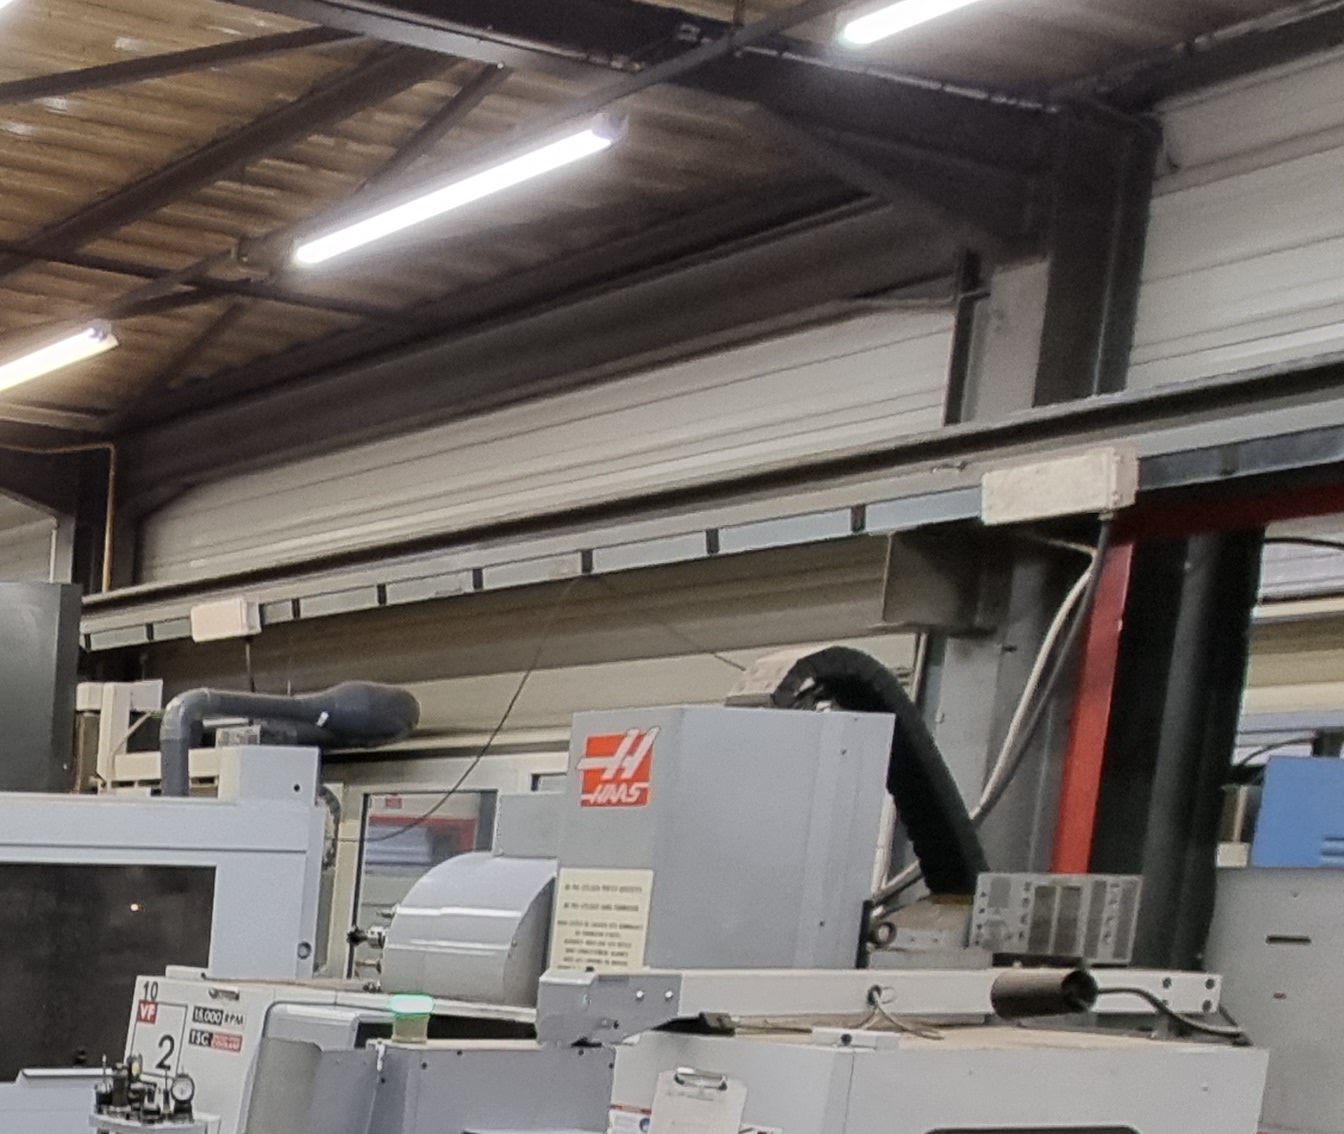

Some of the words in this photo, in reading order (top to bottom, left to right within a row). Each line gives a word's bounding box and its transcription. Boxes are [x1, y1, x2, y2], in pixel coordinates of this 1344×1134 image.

[580, 781, 650, 804] HAAS
[143, 980, 159, 1000] 10
[155, 1033, 175, 1071] 2
